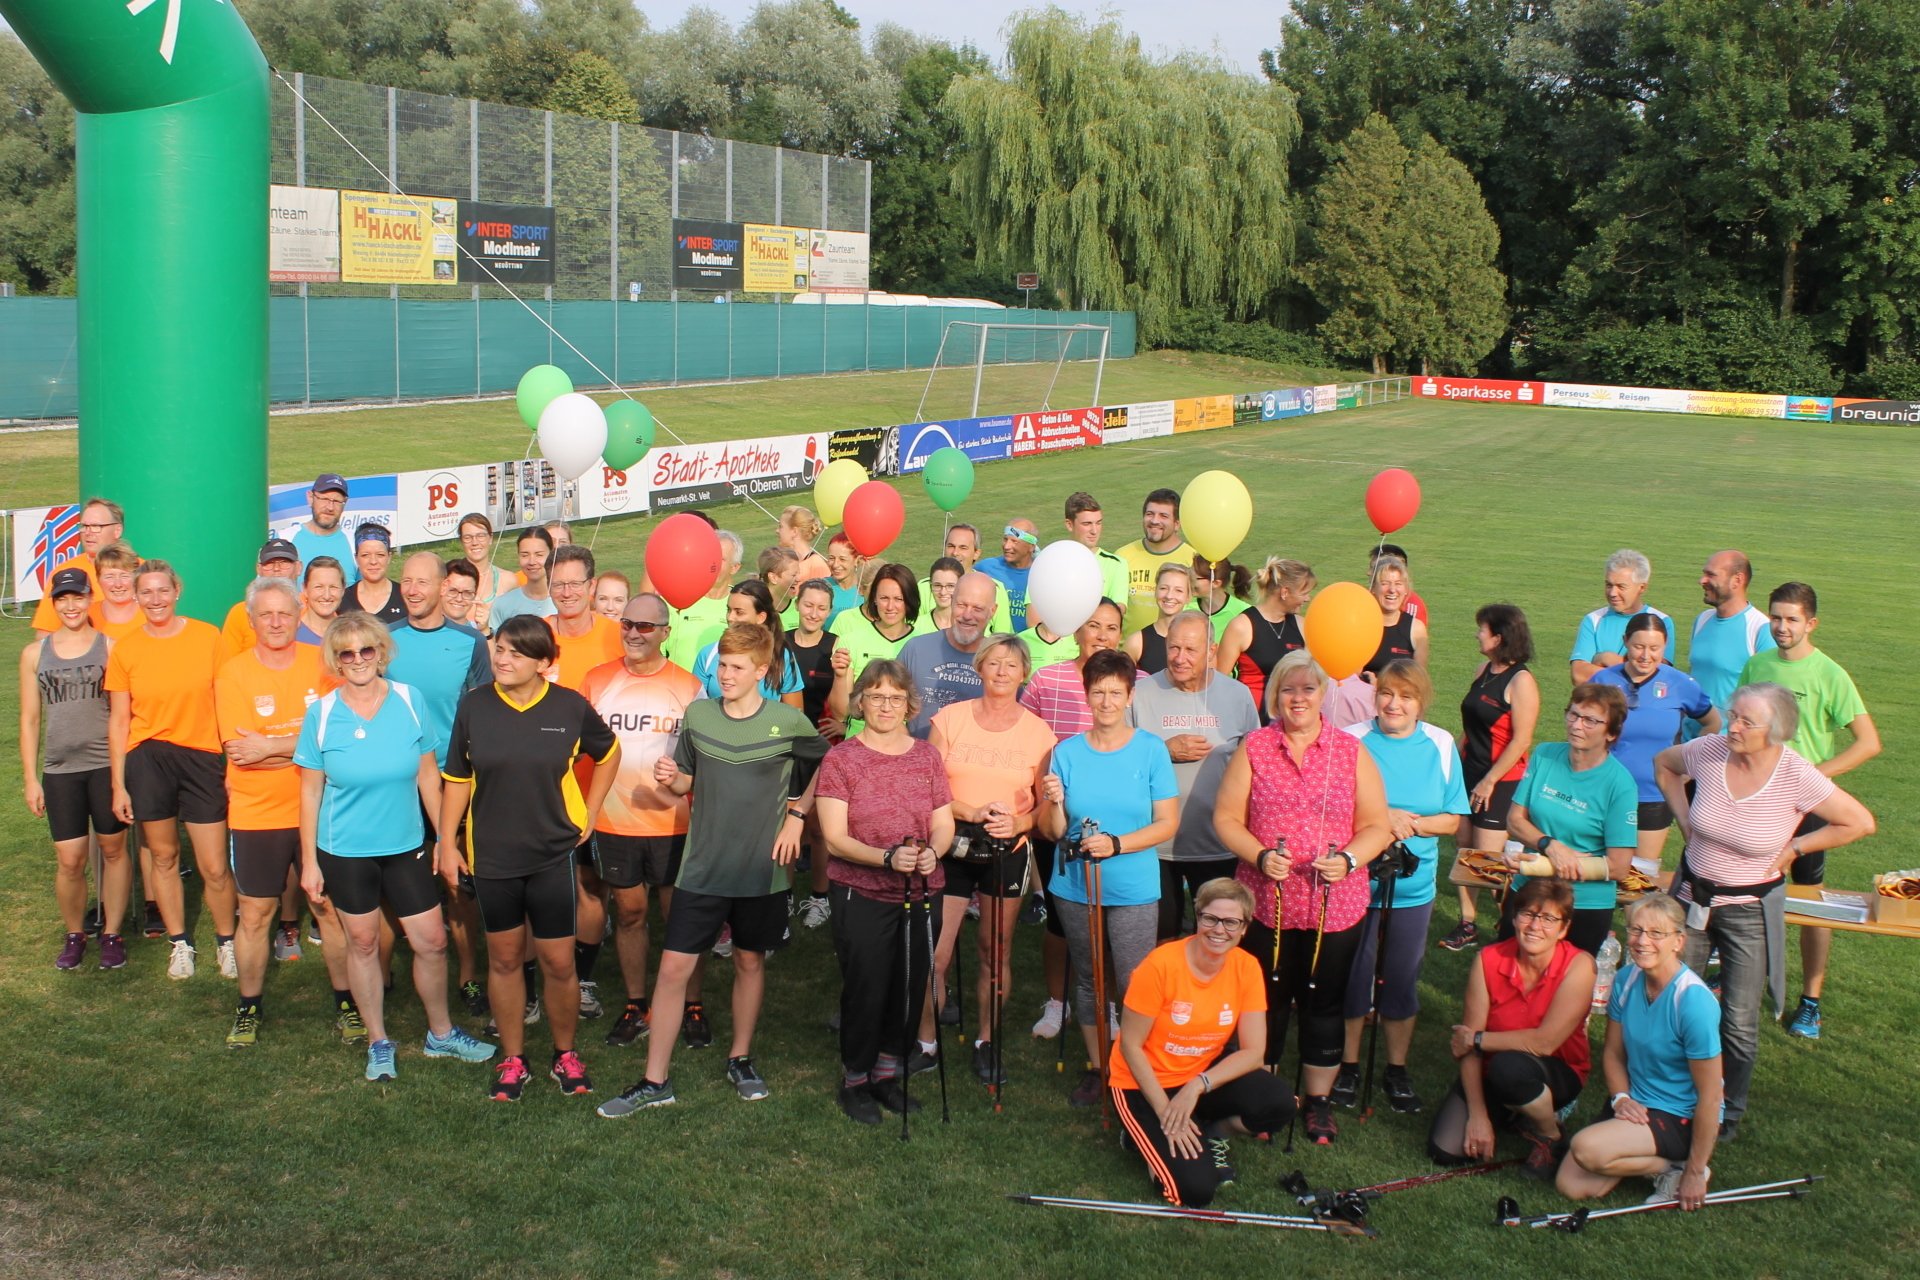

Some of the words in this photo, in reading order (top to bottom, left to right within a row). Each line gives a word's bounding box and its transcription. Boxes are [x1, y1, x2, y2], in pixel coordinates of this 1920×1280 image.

[270, 206, 308, 220] nteam
[368, 218, 422, 241] HÄCKL
[477, 221, 549, 240] INTERSPORT
[483, 240, 541, 257] Modlmair
[687, 236, 739, 252] INTERSPORT
[758, 243, 789, 260] HÄCKL
[692, 251, 734, 266] Modlmair
[1443, 384, 1512, 400] Sparkasse
[1553, 388, 1590, 399] Perseus
[1619, 392, 1650, 402] Reisen
[1686, 404, 1713, 412] Richard
[1013, 440, 1036, 453] HABERL
[653, 444, 780, 486] Stadt-Apotheke
[602, 466, 627, 489] PS
[732, 483, 748, 496] am
[749, 478, 783, 494] Oberen
[783, 474, 798, 488] Tor
[427, 482, 459, 511] PS
[657, 494, 698, 507] Neumarkt-St.
[698, 491, 711, 501] Veit
[428, 511, 459, 520] Automaten
[603, 712, 680, 734] AUF10!
[1162, 714, 1192, 728] BEAST
[1194, 715, 1221, 728] MODE
